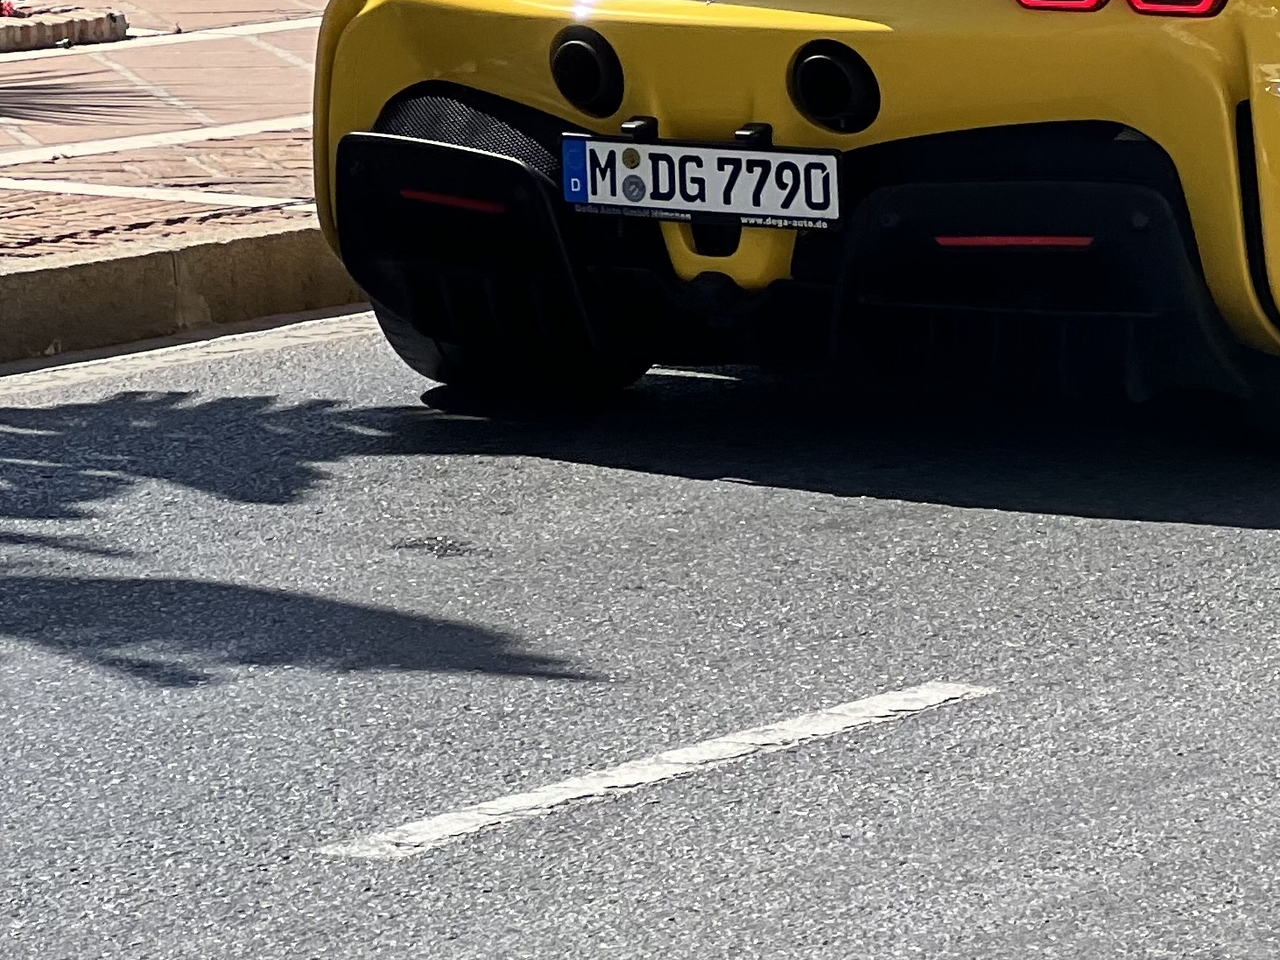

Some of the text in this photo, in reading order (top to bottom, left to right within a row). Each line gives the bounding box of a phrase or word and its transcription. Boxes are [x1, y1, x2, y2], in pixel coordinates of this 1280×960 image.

[571, 178, 580, 192] D
[589, 148, 831, 211] M DG 7790
[740, 216, 828, 230] www.dega-auto.de
